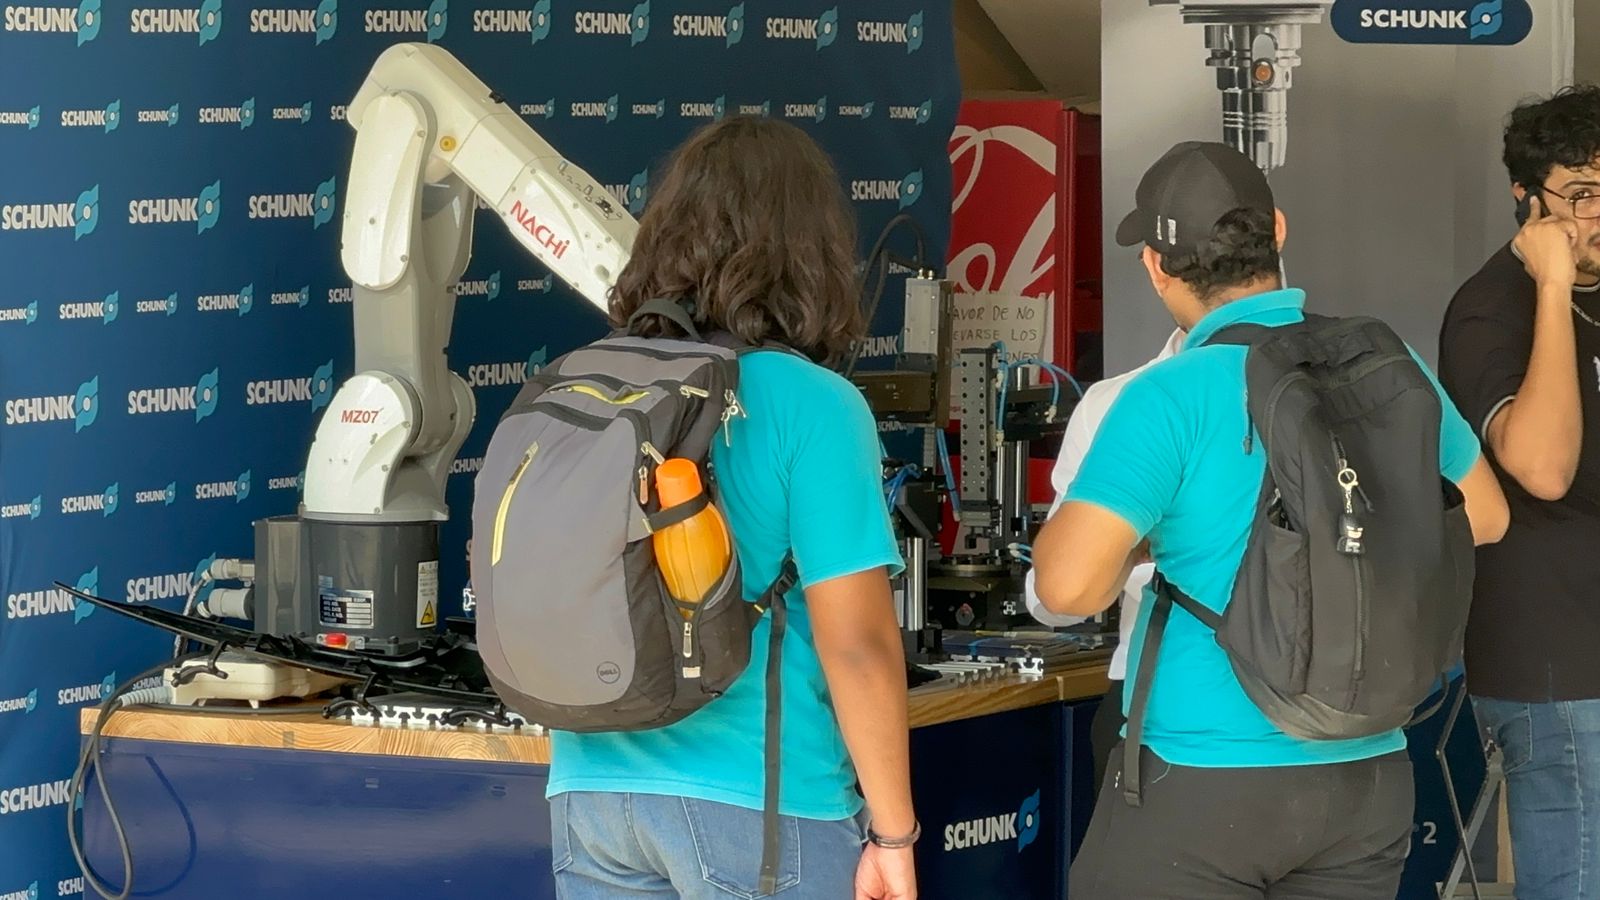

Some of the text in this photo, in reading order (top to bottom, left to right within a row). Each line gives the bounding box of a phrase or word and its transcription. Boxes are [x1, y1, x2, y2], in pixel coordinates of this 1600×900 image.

[5, 6, 78, 32] SCHUNK
[131, 9, 200, 32] SCHUNK
[250, 9, 316, 32] SCHUNK
[365, 9, 427, 32] SCHUNK
[473, 10, 532, 32] SCHUNK
[575, 12, 631, 34] SCHUNK
[673, 15, 727, 37] SCHUNK
[766, 18, 818, 39] SCHUNK
[1360, 9, 1467, 29] SCHUNK
[857, 20, 907, 42] SCHUNK
[61, 110, 105, 126] SCHUNK
[138, 110, 169, 122] SCHUNK
[199, 107, 241, 123] SCHUNK
[273, 107, 302, 119] SCHUNK
[520, 104, 546, 116] SCHUNK
[571, 102, 607, 117] SCHUNK
[632, 103, 659, 115] SCHUNK
[680, 103, 714, 117] SCHUNK
[785, 104, 817, 118] SCHUNK
[852, 180, 901, 200] SCHUNK
[129, 198, 198, 224] SCHUNK
[249, 195, 313, 218] SCHUNK
[2, 203, 75, 230] SCHUNK
[453, 280, 489, 296] CHUNK
[518, 279, 543, 290] SCHUNK
[197, 294, 239, 311] SCHUNK
[271, 292, 300, 305] SCHUNK
[328, 288, 353, 304] SCHU
[59, 301, 104, 319] SCHUNK
[136, 300, 166, 312] SCHUNK
[952, 305, 1035, 321] AVOR DE NO
[953, 328, 1037, 341] EVARSE LOS
[468, 362, 527, 387] SCHUNK
[128, 386, 196, 414] SCHUNK
[246, 379, 312, 405] SCHUNK
[6, 398, 75, 424] SCHUNK
[341, 410, 378, 424] MZ07
[195, 482, 238, 499] SCHUNK
[268, 477, 297, 490] SCHUNK
[61, 494, 104, 513] SCHUNK
[136, 490, 166, 503] SCHUNK
[1, 504, 31, 517] SCHUNK
[126, 572, 195, 602] SCHUNK
[7, 588, 75, 619] SCHUNK
[58, 684, 102, 705] SCHUNK
[0, 698, 27, 712] SCHUNK
[0, 779, 72, 814] SCHUNK
[944, 812, 1017, 852] SCHUNK
[1423, 822, 1437, 844] 2
[58, 877, 84, 896] SCHU
